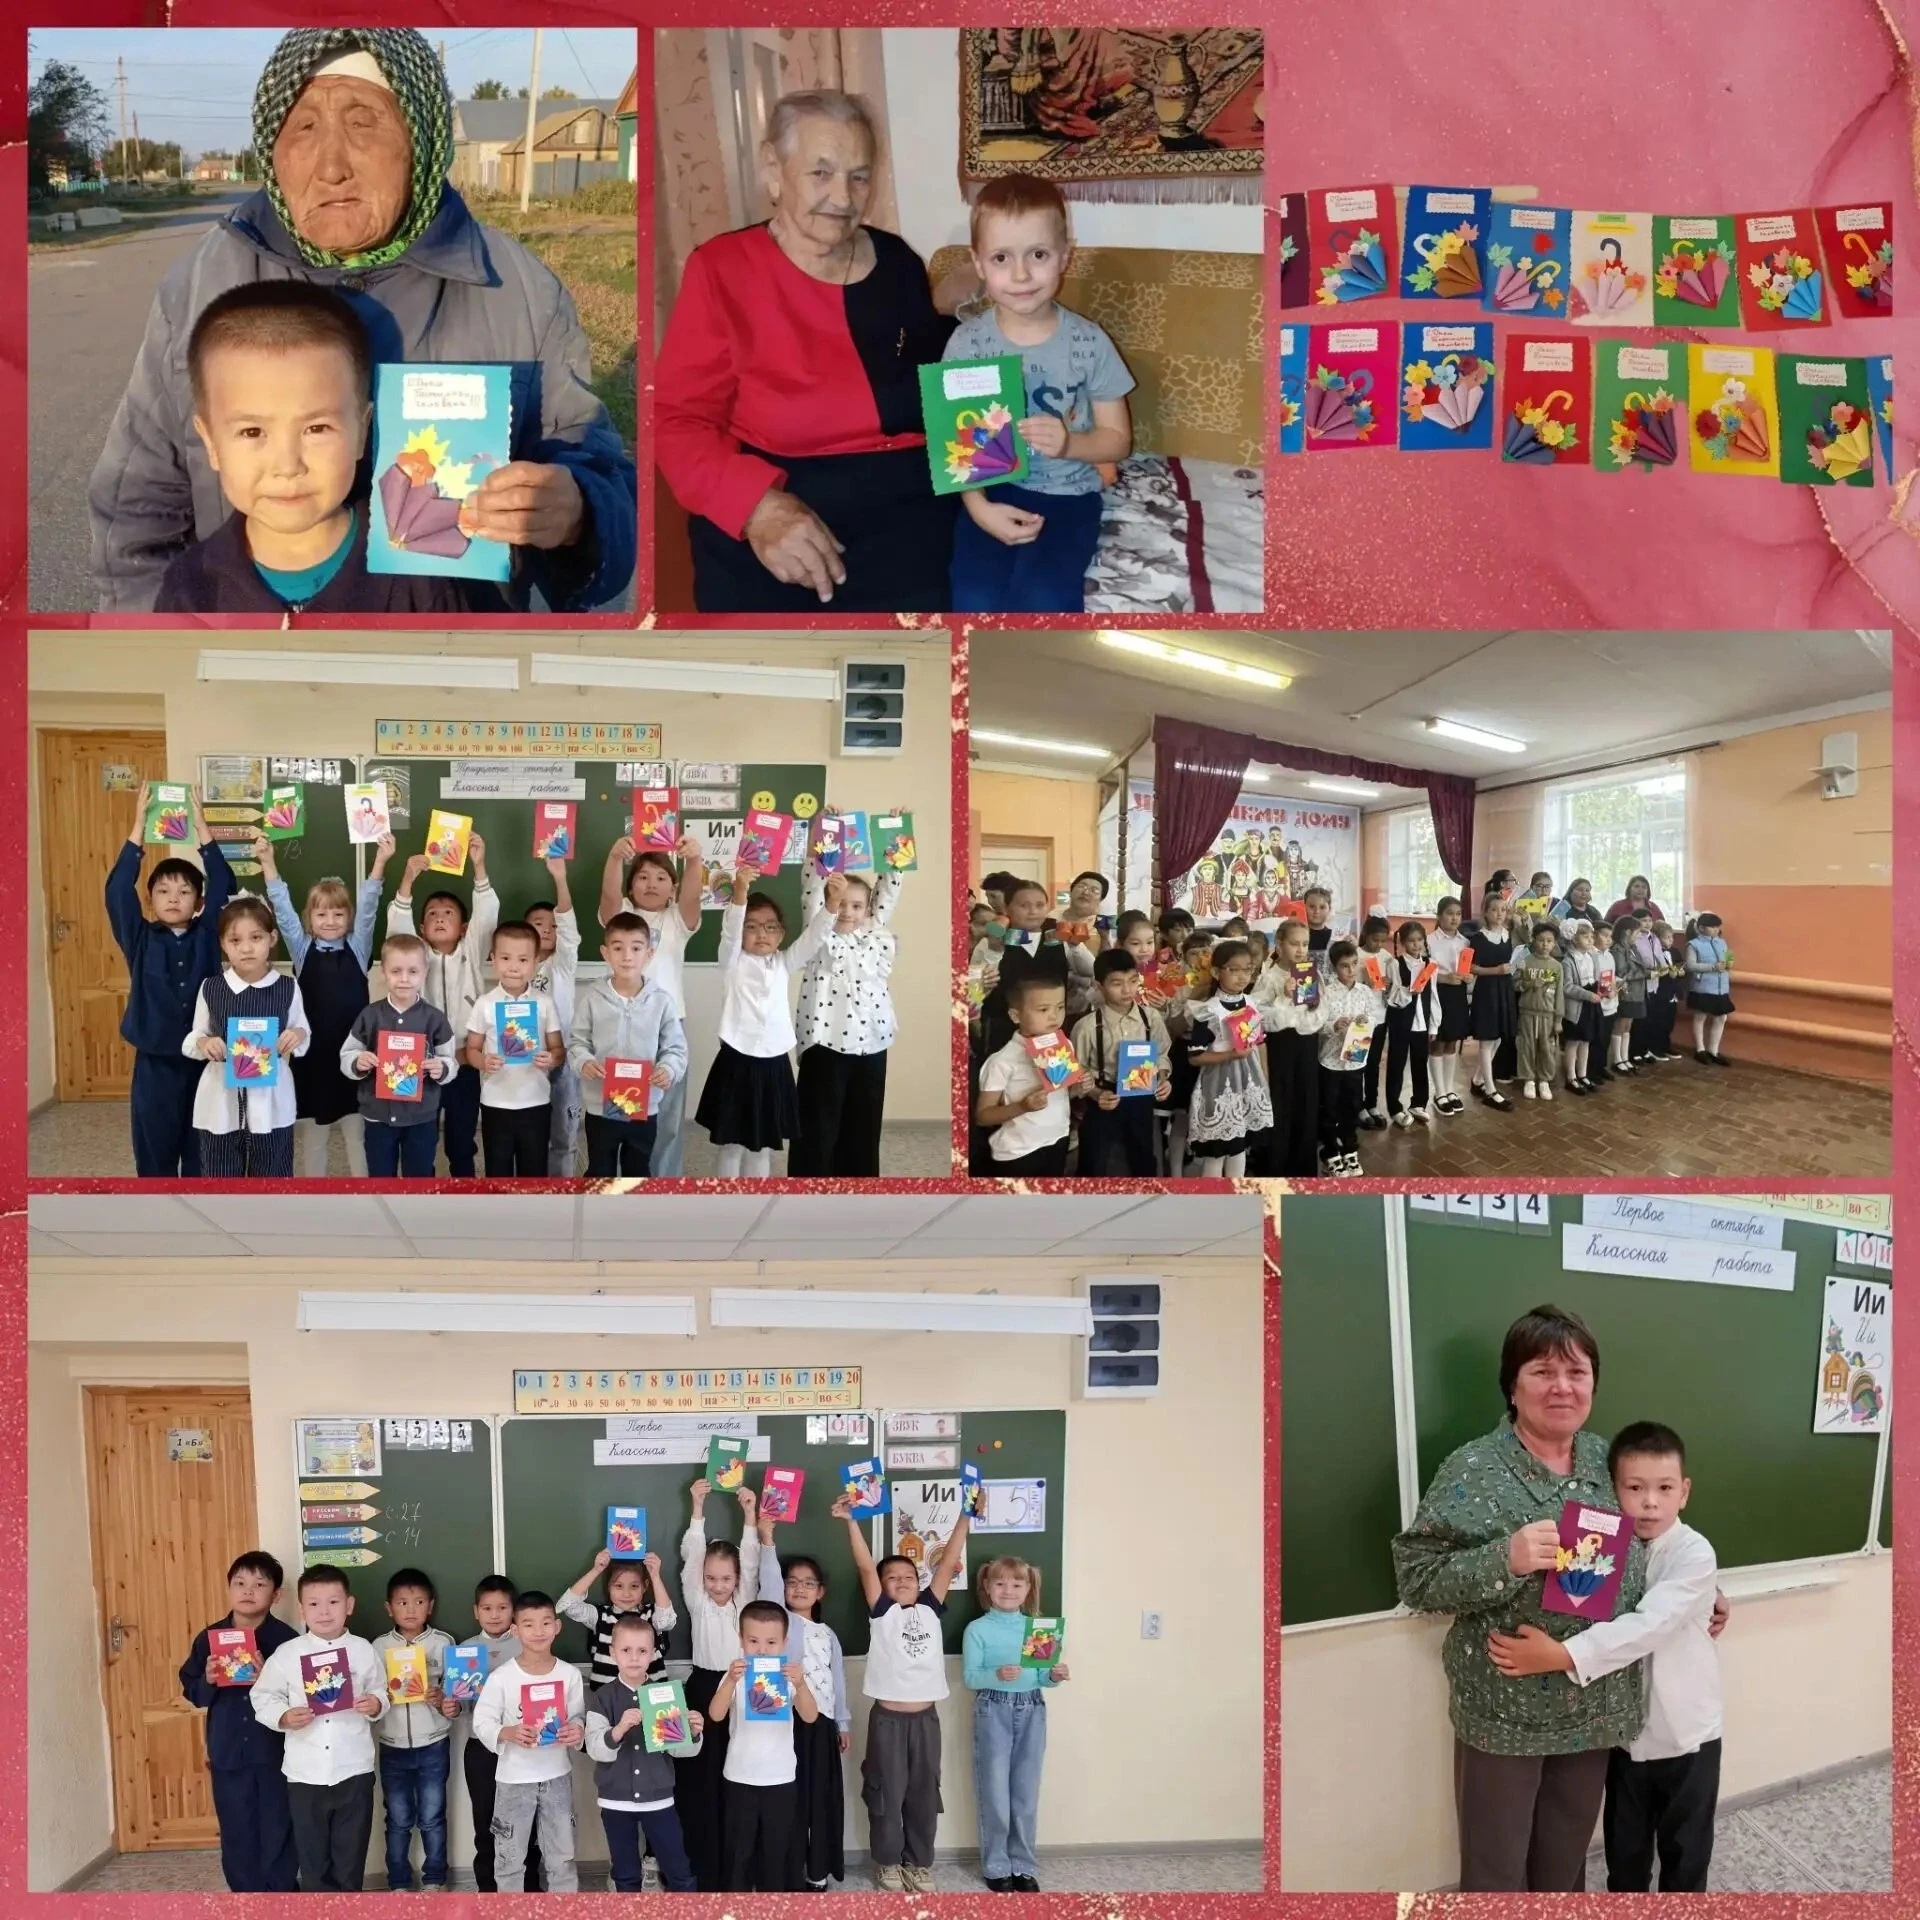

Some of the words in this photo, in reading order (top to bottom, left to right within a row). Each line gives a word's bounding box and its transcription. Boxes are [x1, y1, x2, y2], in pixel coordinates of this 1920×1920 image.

[380, 724, 387, 734] 0
[395, 724, 400, 734] 1
[407, 725, 414, 735] 2
[421, 725, 428, 735] 3
[435, 725, 441, 735] 4
[447, 725, 454, 735] 5
[461, 726, 468, 735] 6
[474, 725, 481, 735] 7
[488, 726, 495, 736] 8
[501, 726, 508, 736] 9
[513, 726, 523, 736] 10
[527, 726, 537, 736] 11
[541, 726, 551, 736] 12
[554, 726, 564, 736] 13
[568, 727, 578, 737] 14
[582, 727, 592, 737] 15
[595, 727, 605, 737] 16
[608, 727, 619, 738] 17
[622, 728, 632, 738] 18
[636, 728, 646, 738] 19
[649, 728, 659, 739] 20
[452, 780, 500, 792] Классная
[528, 779, 570, 796] работа
[708, 821, 736, 838] Ии
[1526, 1193, 1541, 1215] 4
[1612, 1196, 1665, 1227] Первое
[1710, 1215, 1766, 1241] октября
[1585, 1233, 1670, 1265] Классная
[1711, 1250, 1774, 1278] работа
[1853, 1284, 1886, 1316] Ии
[518, 1375, 527, 1388] 0
[536, 1375, 543, 1388] 1
[552, 1375, 559, 1388] 2
[568, 1375, 577, 1388] 3
[585, 1375, 593, 1388] 4
[600, 1375, 608, 1388] 5
[618, 1375, 626, 1388] 6
[634, 1375, 642, 1388] 7
[650, 1375, 658, 1387] 8
[666, 1375, 674, 1387] 9
[680, 1375, 693, 1387] 10
[697, 1373, 708, 1386] 11
[714, 1373, 726, 1386] 12
[730, 1373, 742, 1386] 13
[747, 1373, 759, 1385] 14
[764, 1372, 775, 1385] 15
[780, 1372, 792, 1385] 16
[796, 1372, 809, 1385] 17
[813, 1371, 825, 1385] 18
[830, 1371, 842, 1384] 19
[846, 1371, 859, 1384] 20
[567, 1399, 577, 1408] 30
[583, 1399, 593, 1408] 40
[600, 1399, 609, 1408] 50
[615, 1399, 625, 1408] 60
[631, 1398, 641, 1407] 70
[663, 1398, 673, 1407] 90
[678, 1398, 692, 1407] 100
[626, 1419, 663, 1436] Первое
[697, 1417, 742, 1435] октября
[891, 1419, 920, 1432] ЗВУК
[457, 1430, 466, 1442] 4
[608, 1442, 668, 1457] Классная
[892, 1452, 926, 1464] БУКВА
[922, 1482, 956, 1503] Ии
[1005, 1486, 1029, 1526] 5
